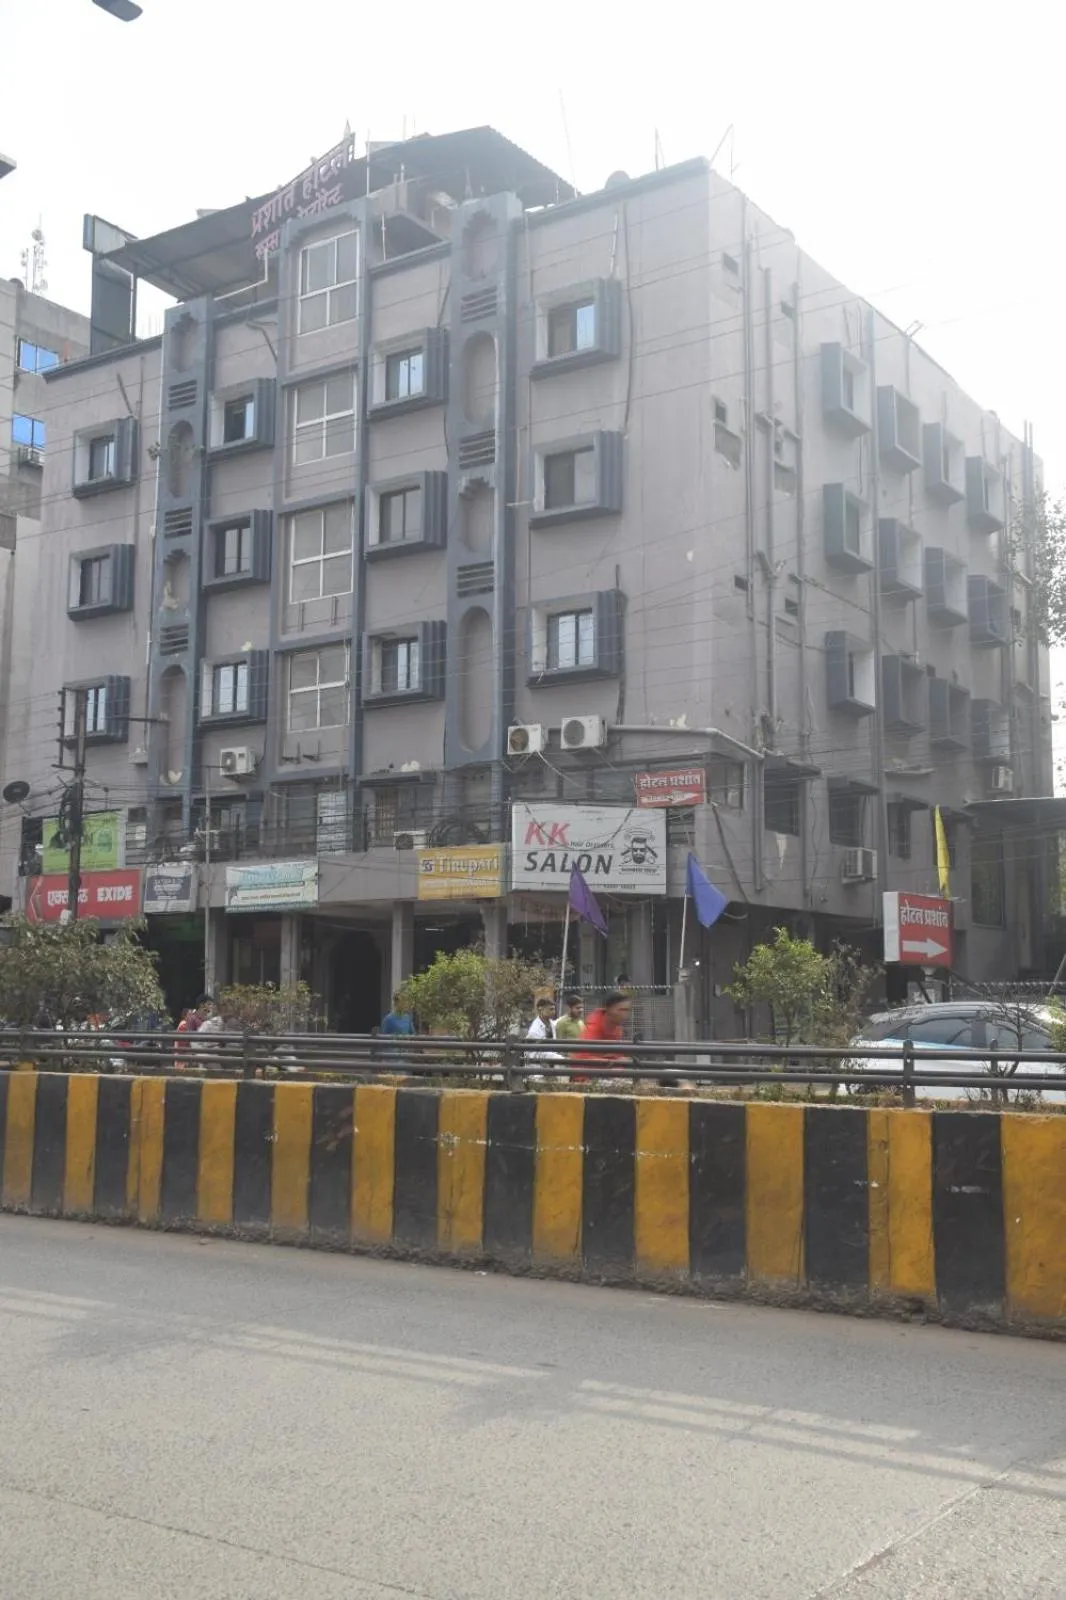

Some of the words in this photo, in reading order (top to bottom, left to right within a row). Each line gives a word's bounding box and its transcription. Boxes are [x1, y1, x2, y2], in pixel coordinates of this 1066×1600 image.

[524, 821, 571, 848] KK
[524, 851, 613, 875] SALON
[96, 885, 133, 903] EXIDE
[899, 899, 923, 926] होटल
[924, 905, 949, 928] प्रशांत
